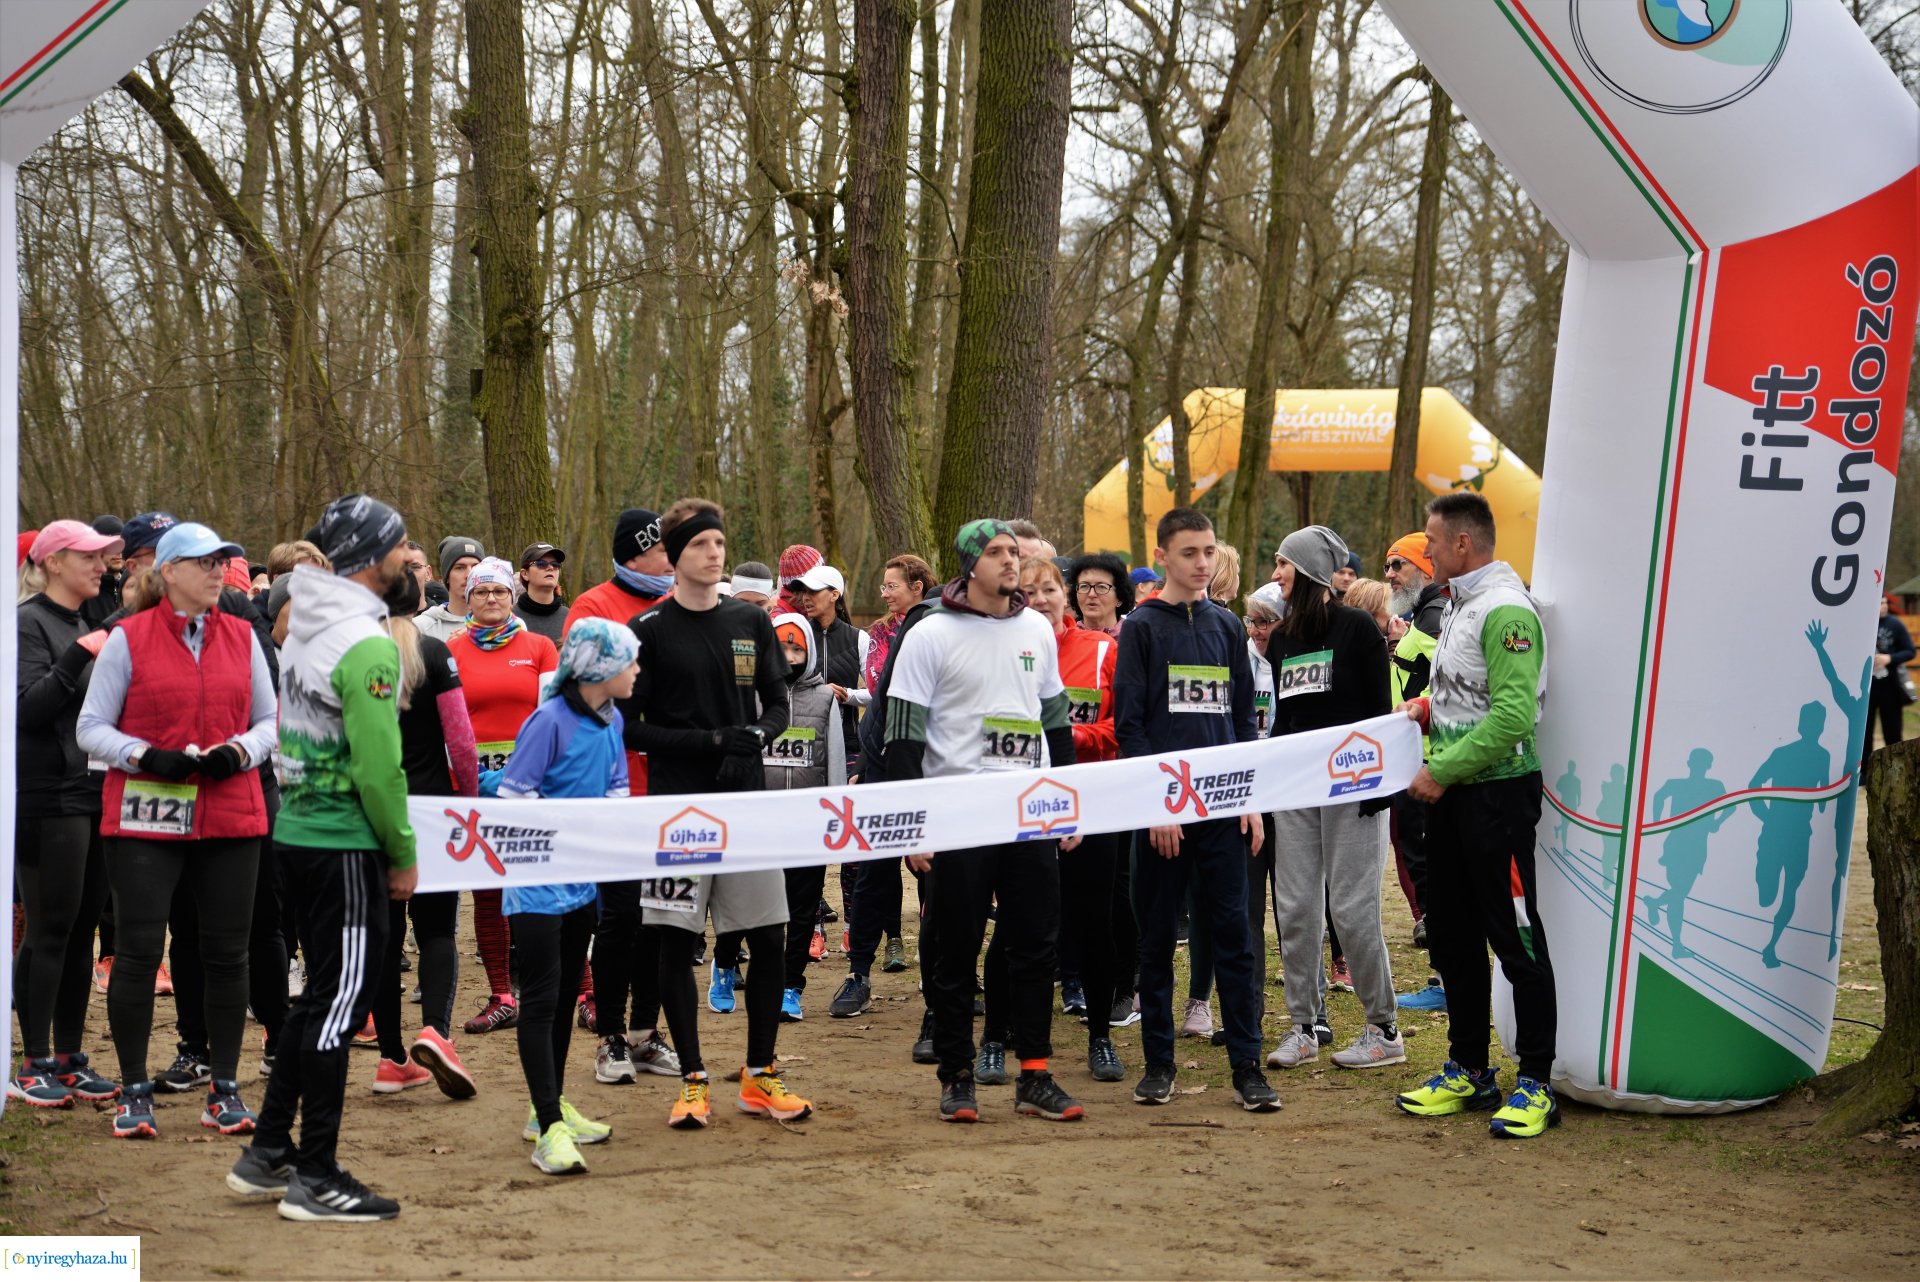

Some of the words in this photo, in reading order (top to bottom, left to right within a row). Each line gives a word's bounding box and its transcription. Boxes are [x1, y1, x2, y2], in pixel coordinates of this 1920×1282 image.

[1273, 403, 1396, 436] kácvirág
[1739, 364, 1820, 492] Fitt
[1271, 429, 1384, 443] UTÓFESZTIVÁL
[1810, 254, 1899, 607] Gondozó
[1282, 663, 1321, 689] 020
[1173, 679, 1218, 702] 151
[764, 738, 804, 758] 146
[986, 731, 1031, 756] 167
[479, 752, 513, 771] 13
[1335, 750, 1375, 768] újház
[1204, 785, 1253, 804] TRAIL
[125, 795, 181, 823] 112
[1027, 798, 1070, 817] újház
[670, 829, 717, 845] újház
[869, 827, 925, 844] TRAIL
[495, 840, 554, 853] TRAIL
[646, 877, 693, 900] 102
